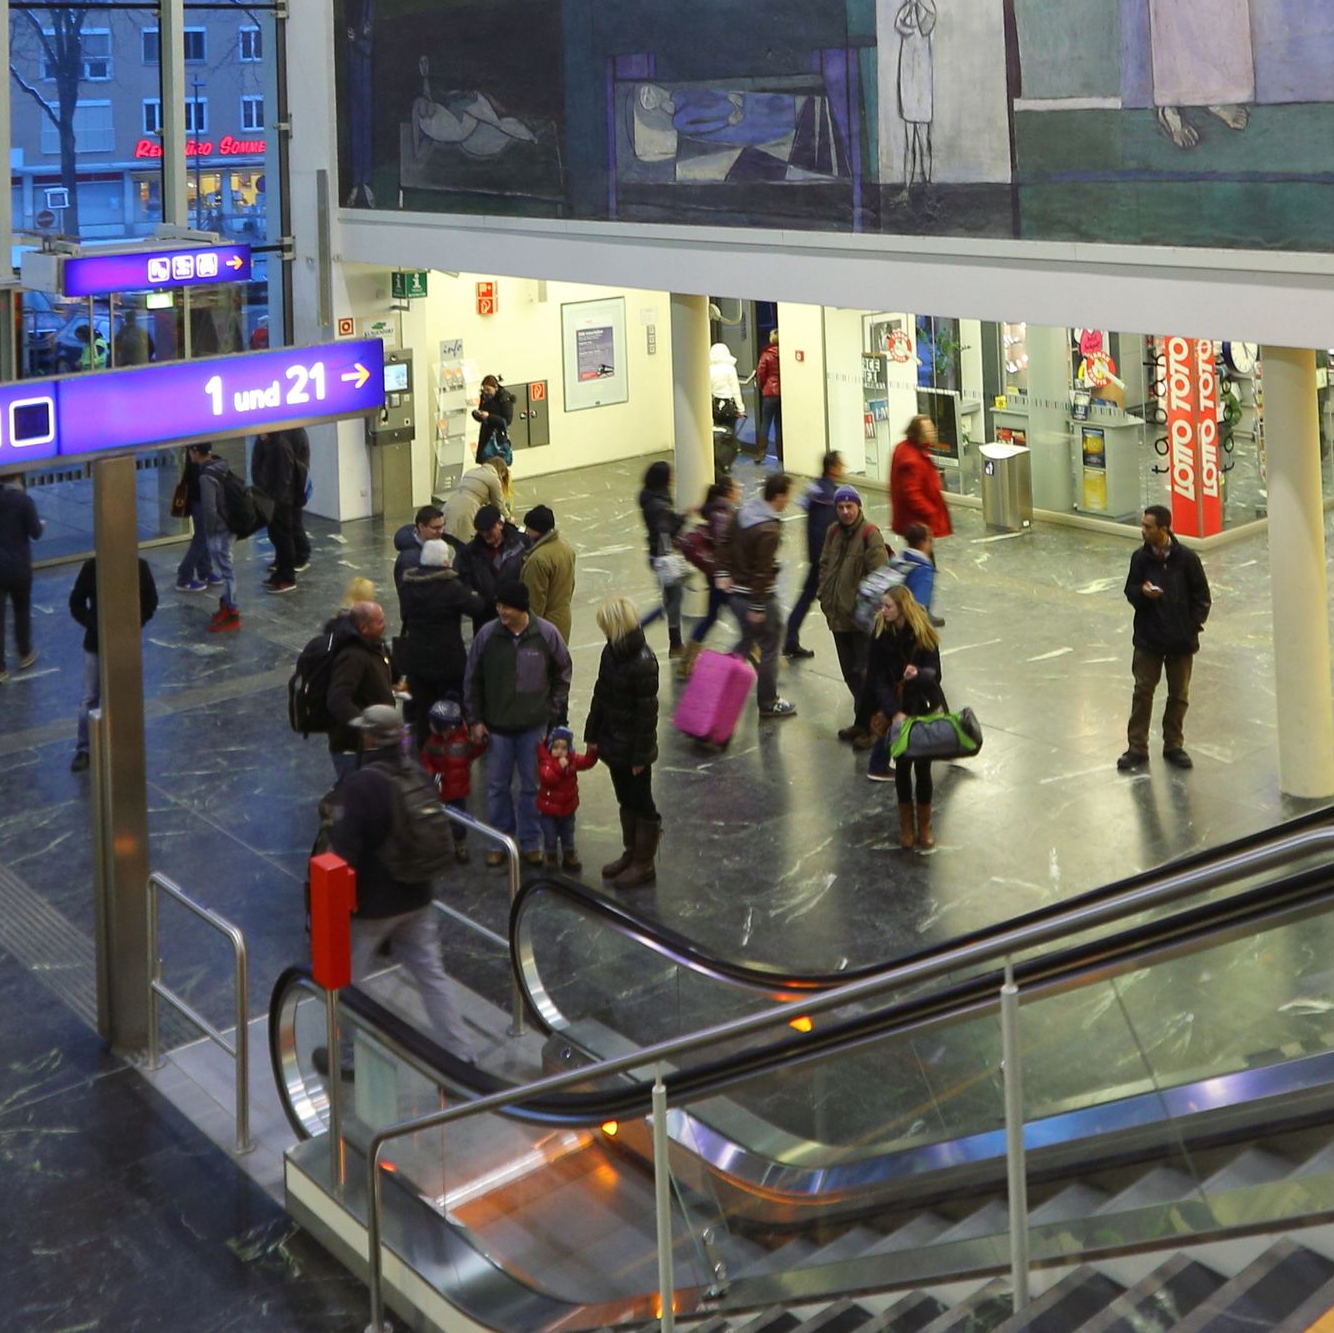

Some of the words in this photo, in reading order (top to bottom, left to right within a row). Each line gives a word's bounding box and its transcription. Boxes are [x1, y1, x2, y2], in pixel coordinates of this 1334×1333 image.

[219, 135, 267, 155] SOMME
[442, 341, 463, 357] info
[1168, 337, 1192, 412] TOTO
[1197, 338, 1215, 412] TOTO
[204, 374, 224, 416] 1
[233, 384, 281, 412] und
[285, 362, 327, 405] 21
[1142, 348, 1170, 474] tabak
[1171, 419, 1196, 501] LOTTO
[1201, 418, 1219, 498] LOTTO
